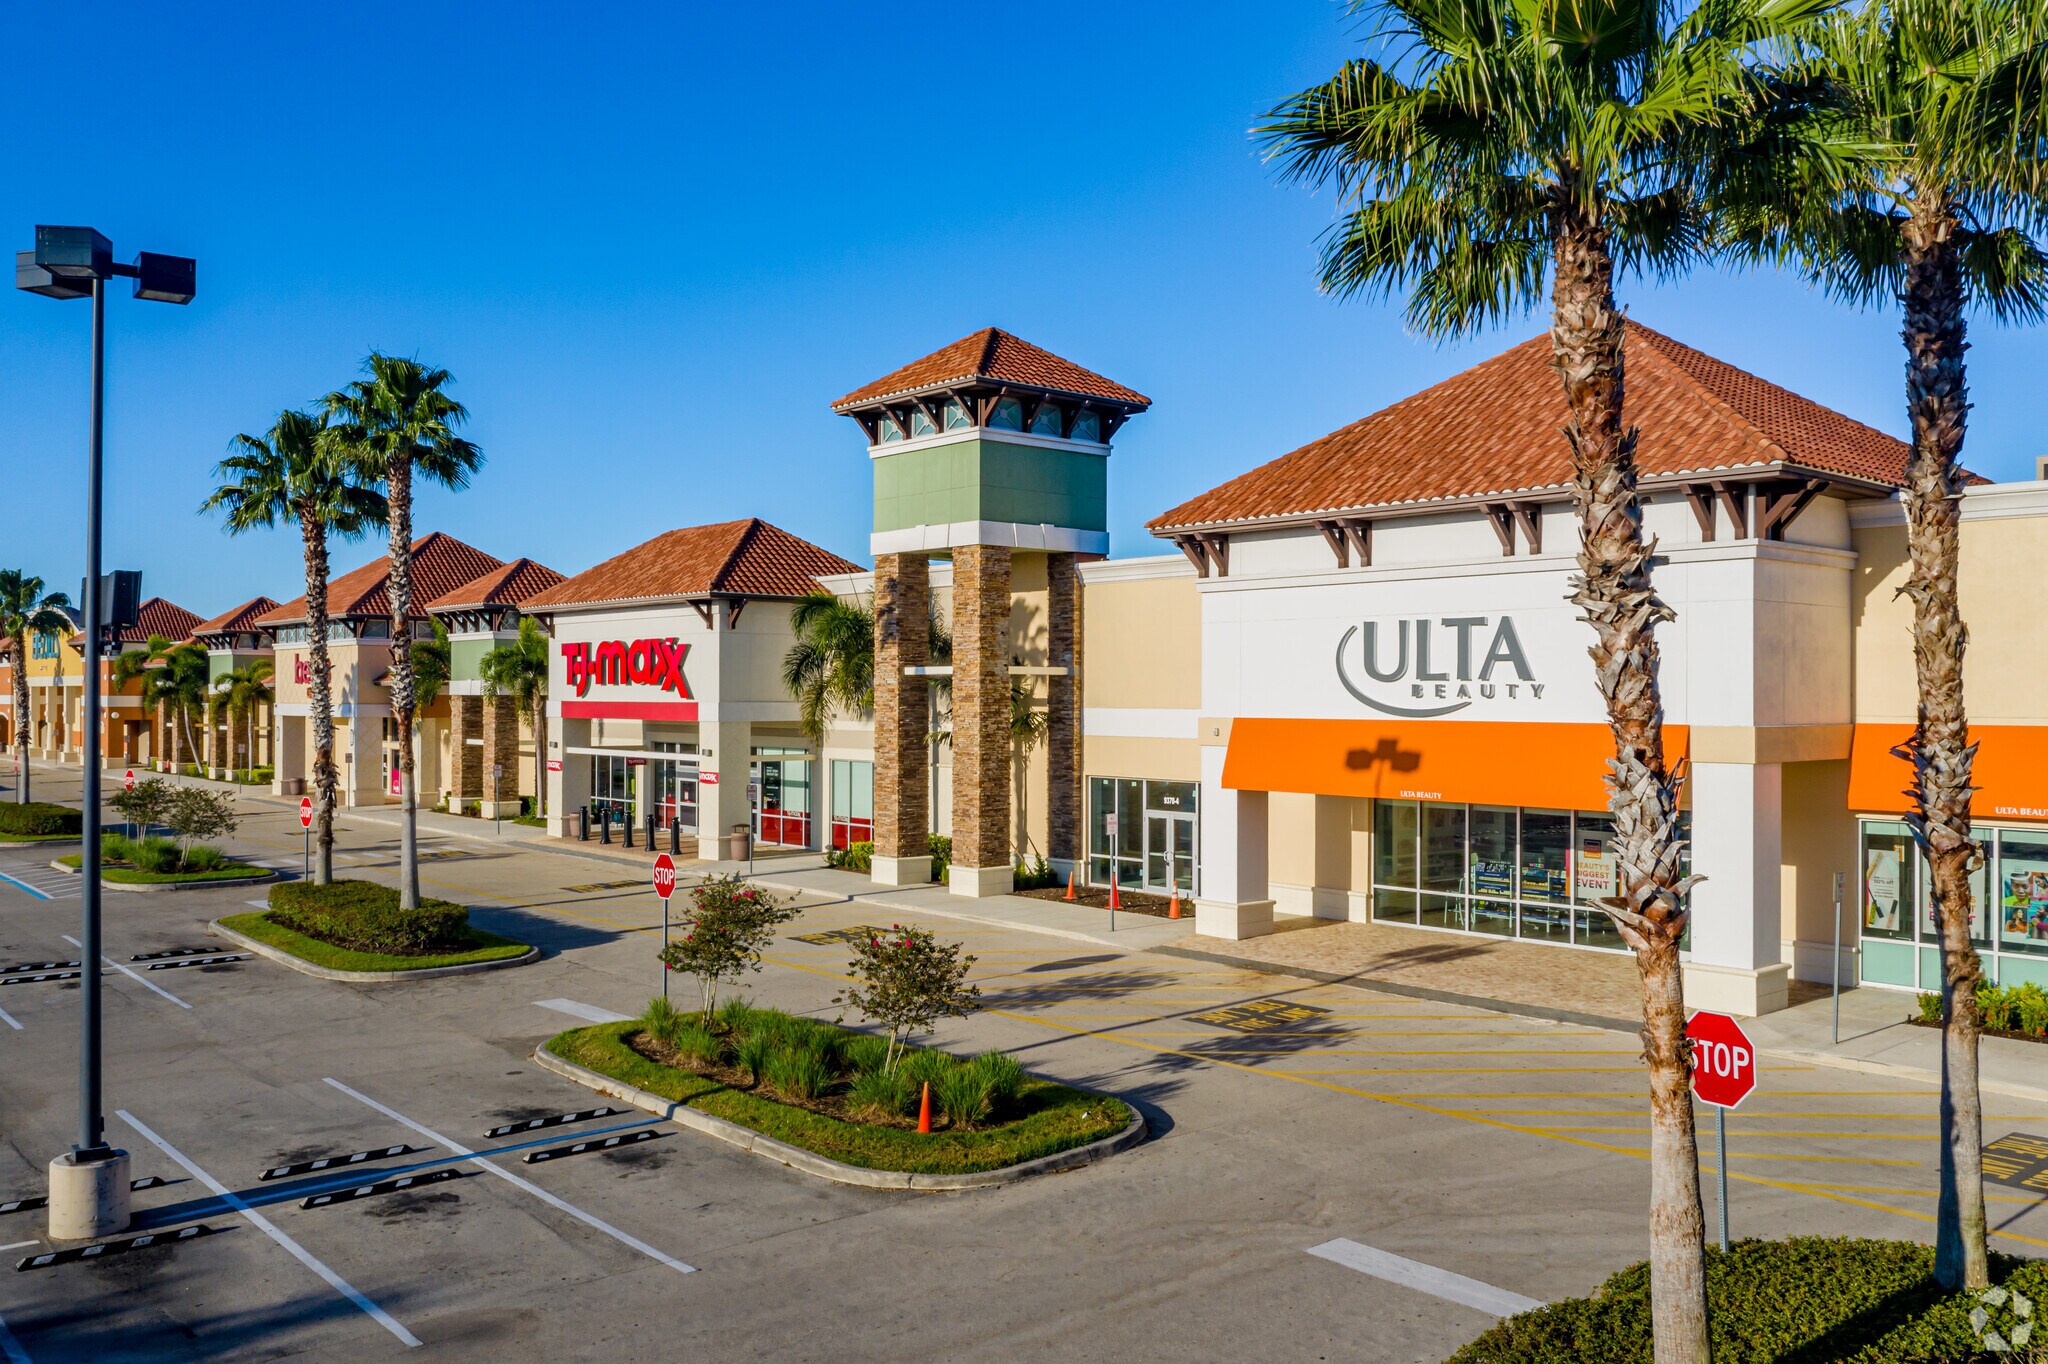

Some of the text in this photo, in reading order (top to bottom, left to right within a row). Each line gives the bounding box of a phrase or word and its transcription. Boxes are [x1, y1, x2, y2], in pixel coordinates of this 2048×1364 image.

[1363, 616, 1535, 683] ULTA
[1411, 683, 1545, 700] BEAUTY
[1416, 791, 1442, 799] BEAUTY
[300, 806, 312, 818] STOP
[1995, 806, 2048, 817] ULTA BEAU
[654, 867, 674, 885] STOP
[1576, 878, 1610, 890] EVENT
